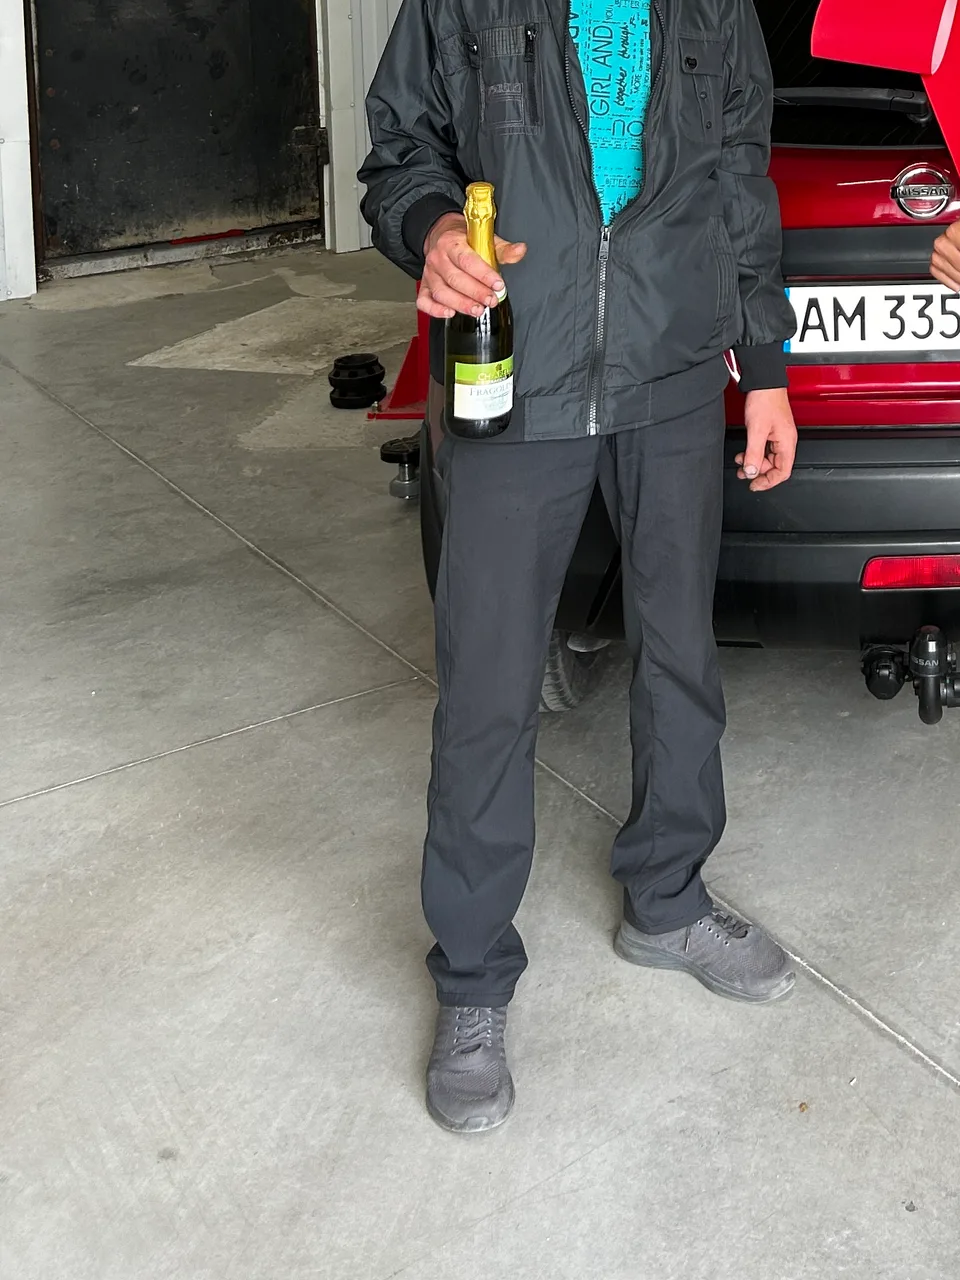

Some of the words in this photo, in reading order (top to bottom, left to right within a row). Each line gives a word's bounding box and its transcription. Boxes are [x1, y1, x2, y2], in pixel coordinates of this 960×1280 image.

[592, 25, 613, 68] AND
[590, 74, 612, 116] GIRL
[899, 186, 949, 197] NISSAN
[799, 296, 866, 342] AM
